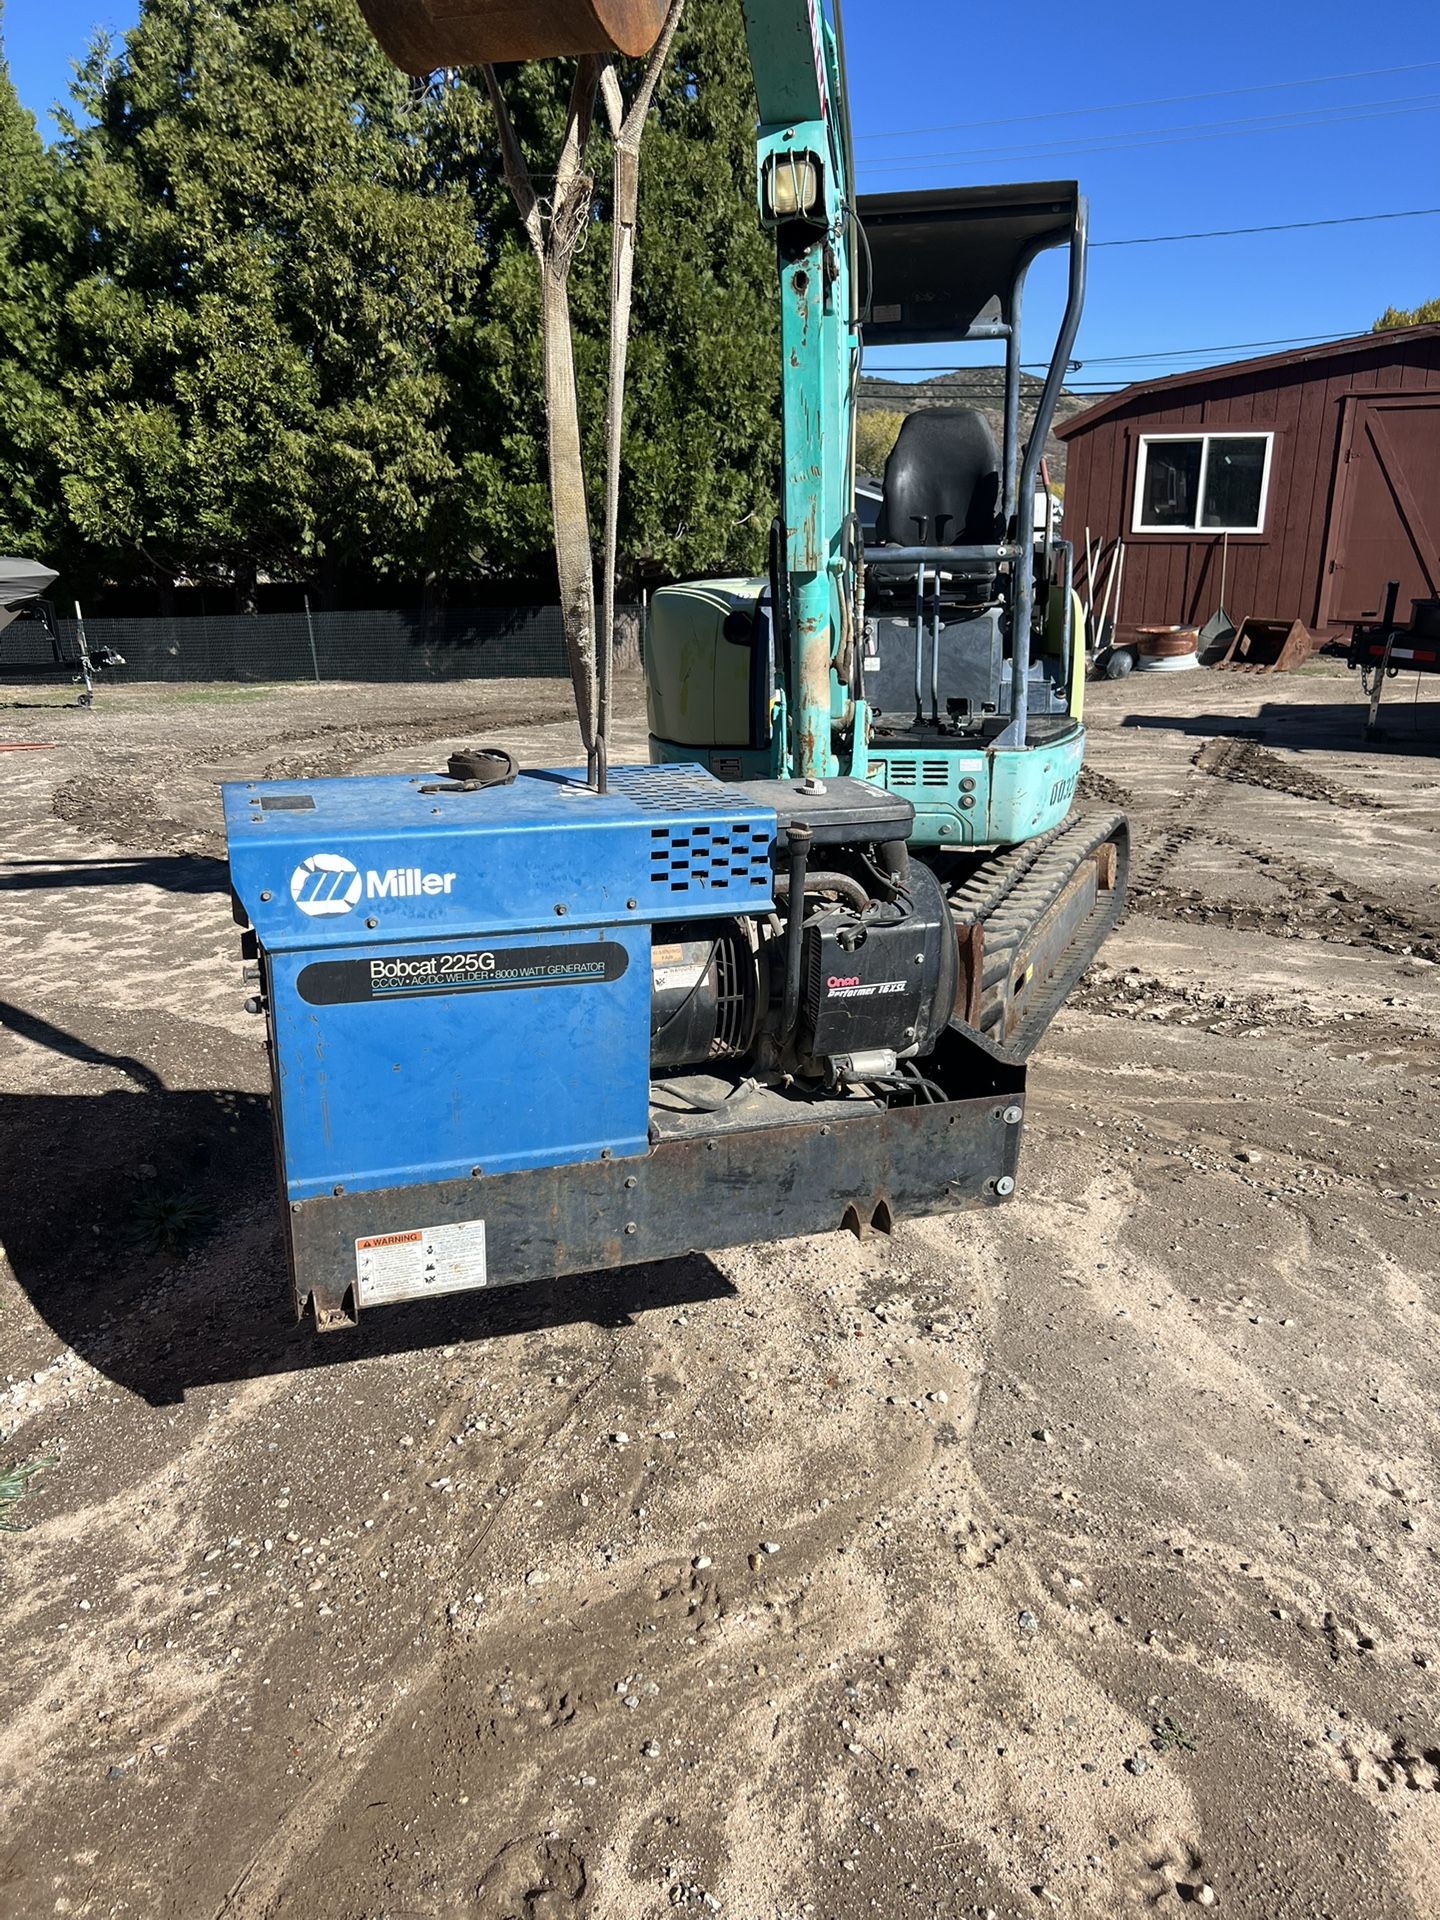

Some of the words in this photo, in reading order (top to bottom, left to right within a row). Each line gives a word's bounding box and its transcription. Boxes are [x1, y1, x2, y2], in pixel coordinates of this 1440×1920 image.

[366, 868, 457, 898] Miller
[370, 957, 437, 979] Bobcat
[440, 952, 495, 973] 225G
[411, 974, 445, 985] AC/DC
[445, 971, 489, 983] WELDER
[495, 968, 518, 979] 8000
[519, 965, 547, 977] WATT
[547, 961, 605, 975] GENERATOR
[827, 976, 860, 988] Onan
[827, 986, 877, 998] Performer
[373, 1233, 418, 1246] WARNING
